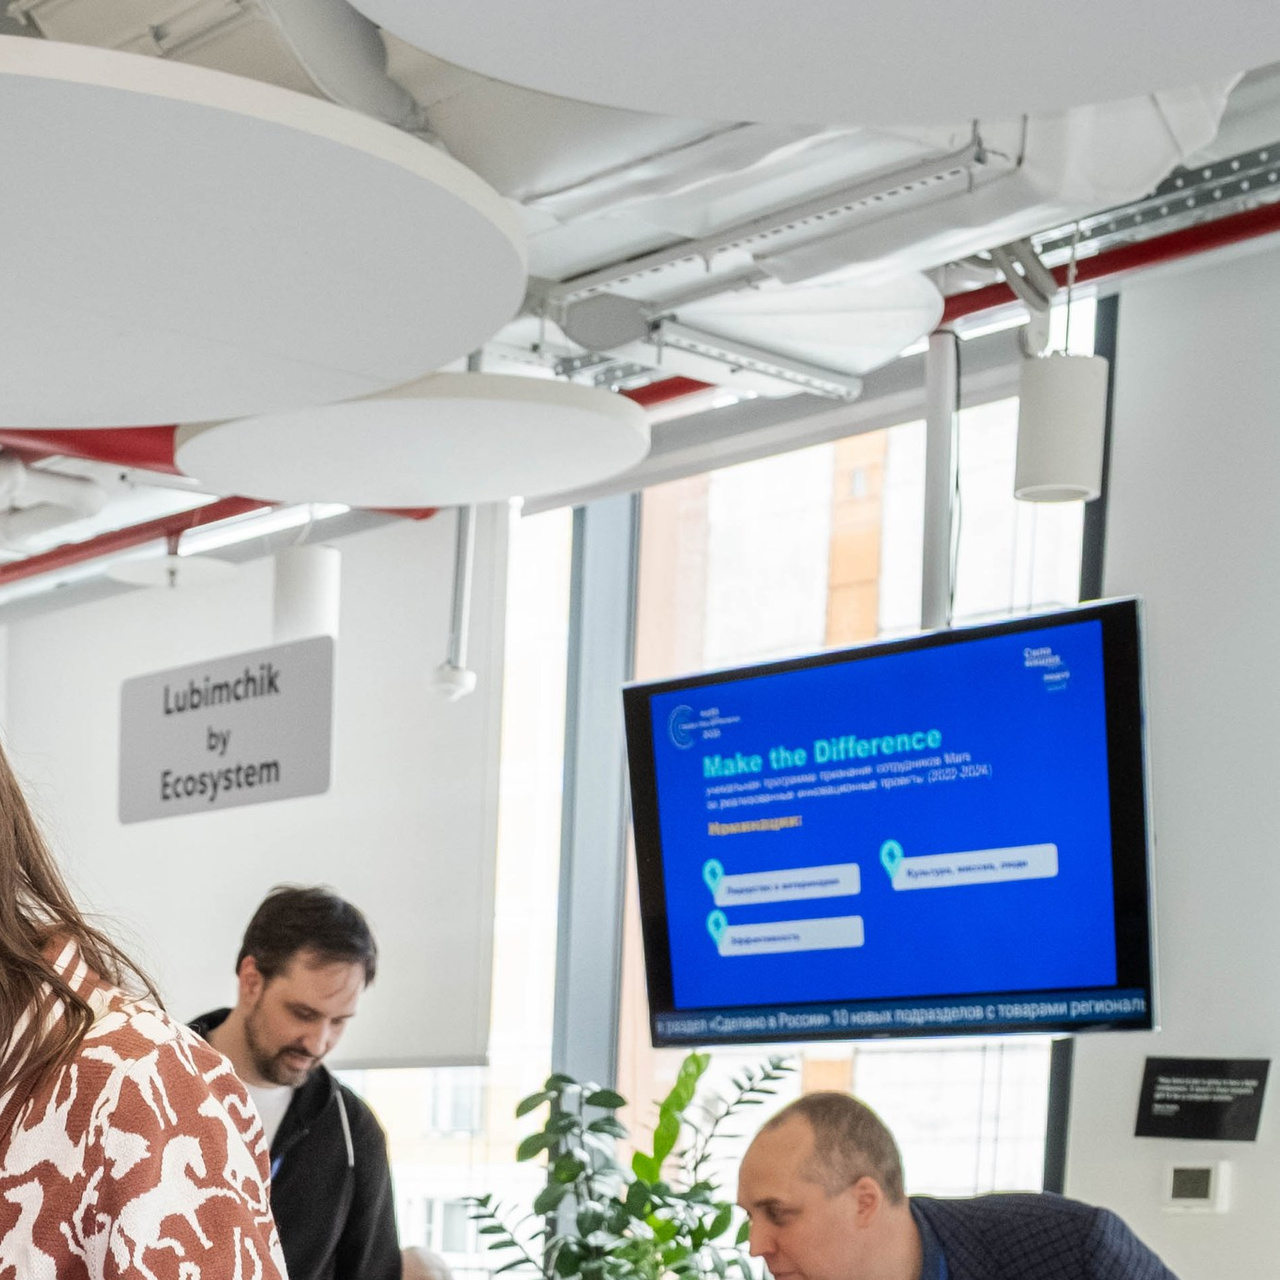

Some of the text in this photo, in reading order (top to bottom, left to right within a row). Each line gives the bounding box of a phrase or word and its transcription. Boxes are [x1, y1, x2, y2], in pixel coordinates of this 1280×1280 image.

[163, 663, 280, 716] Lubimchik
[206, 725, 231, 756] by
[703, 729, 942, 778] Make the Difference
[161, 759, 280, 802] Ecosystem
[850, 1009, 893, 1025] новых
[894, 1004, 984, 1025] подразделов
[985, 1004, 996, 1019] с
[997, 1001, 1068, 1020] товарами
